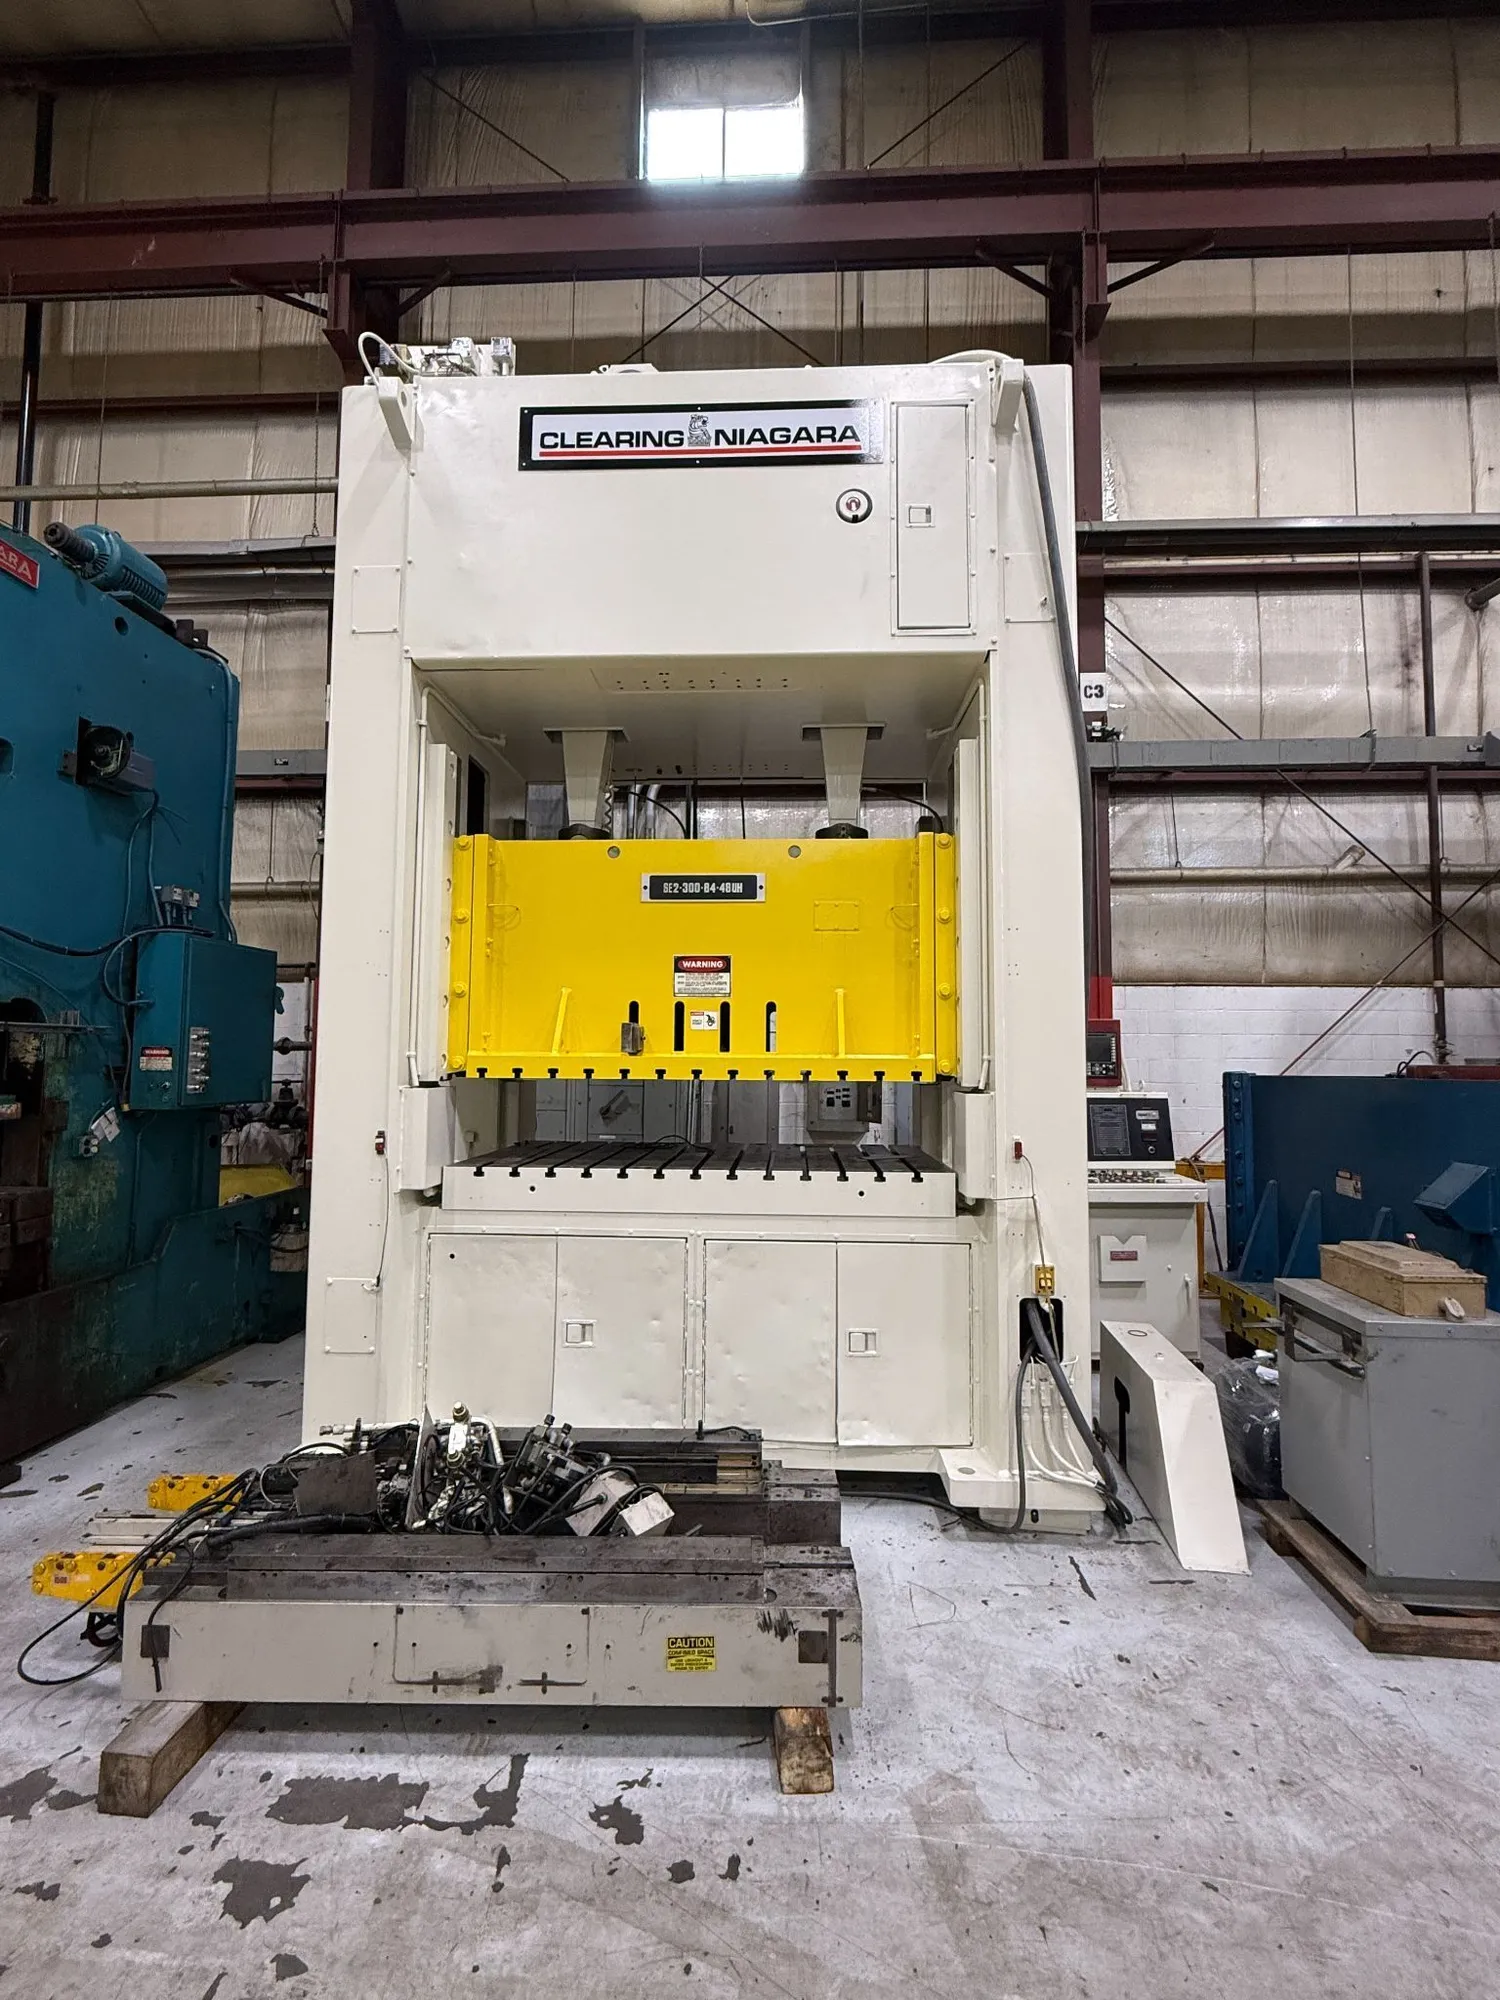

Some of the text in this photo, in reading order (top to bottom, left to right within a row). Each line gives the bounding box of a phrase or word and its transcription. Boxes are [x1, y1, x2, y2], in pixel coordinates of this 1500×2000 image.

[539, 425, 861, 450] CLEARING NIAGARA
[1083, 684, 1104, 699] C3
[682, 960, 723, 968] WARNING
[669, 1637, 713, 1648] CAUTION
